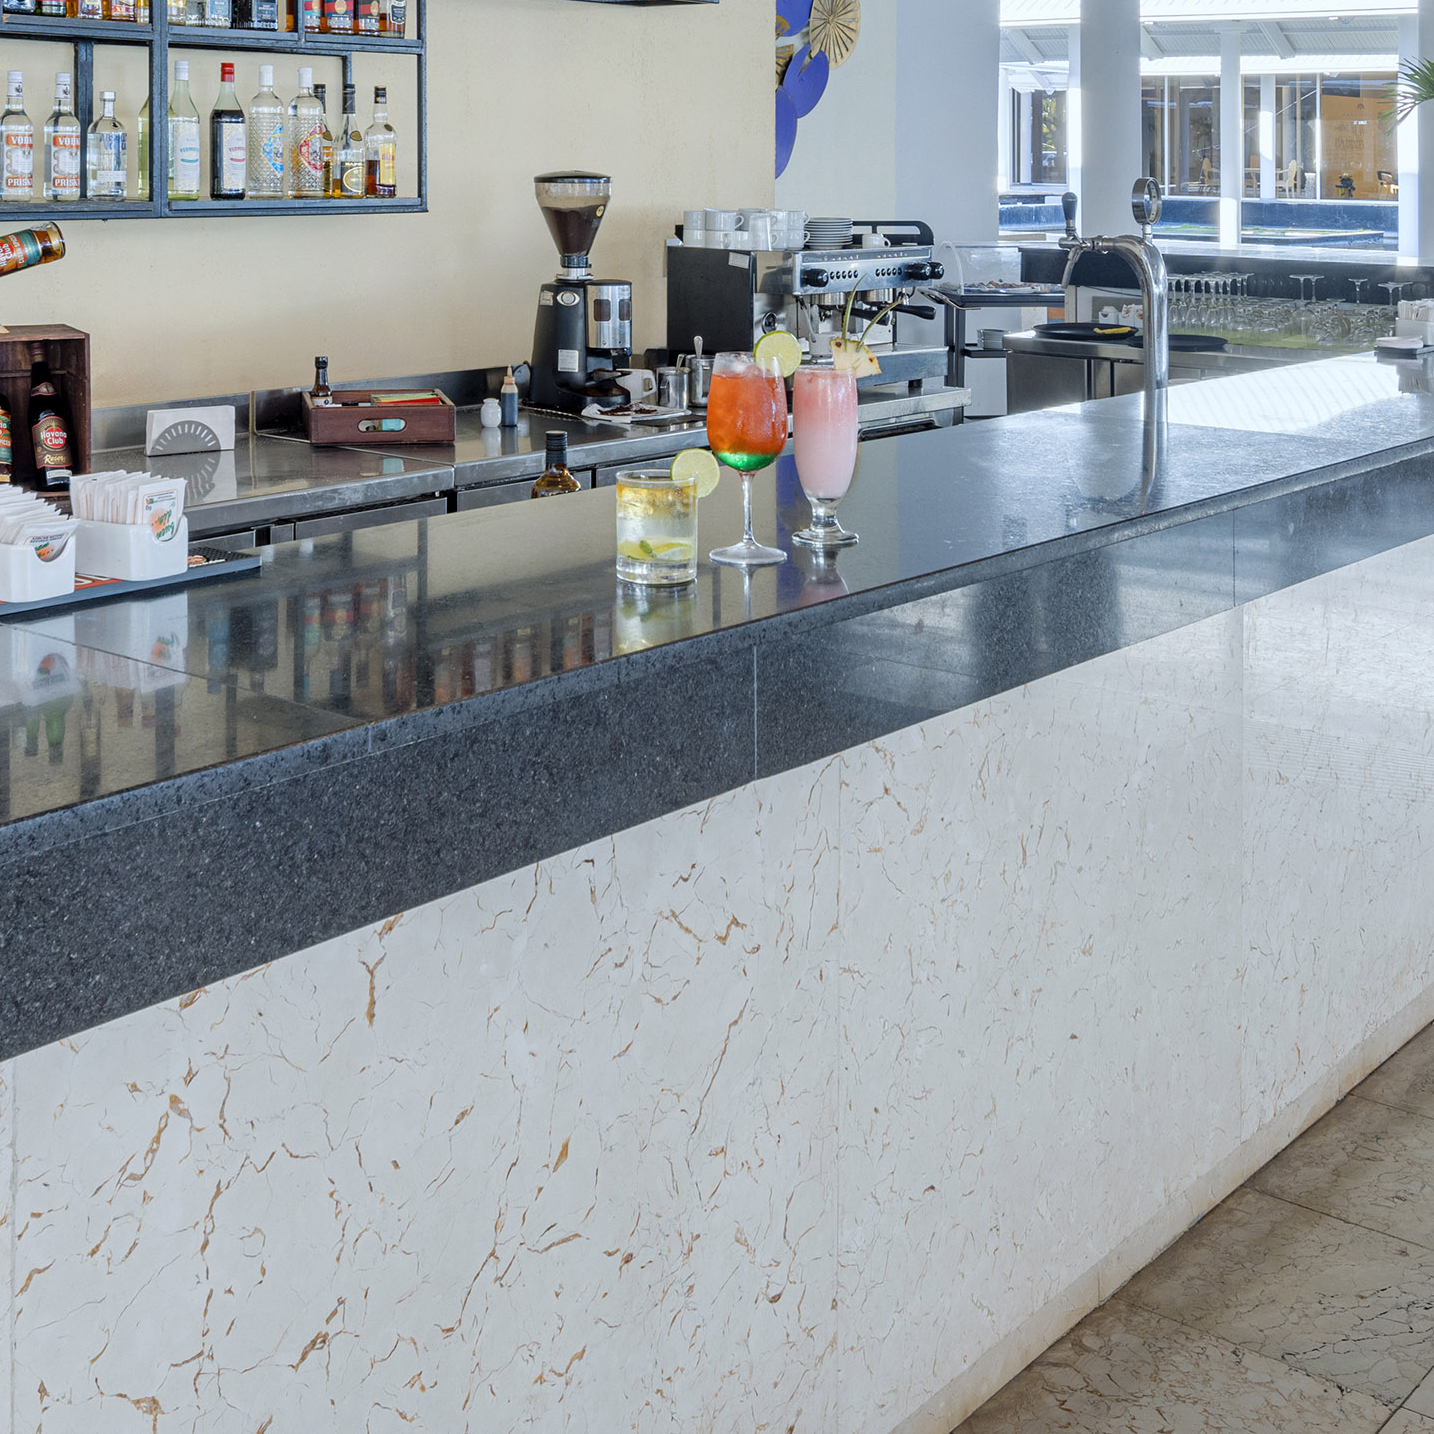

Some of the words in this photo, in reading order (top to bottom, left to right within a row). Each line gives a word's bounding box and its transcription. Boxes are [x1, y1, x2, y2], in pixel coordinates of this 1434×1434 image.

[3, 243, 13, 260] Club
[40, 430, 67, 440] Havana
[47, 437, 65, 445] Club
